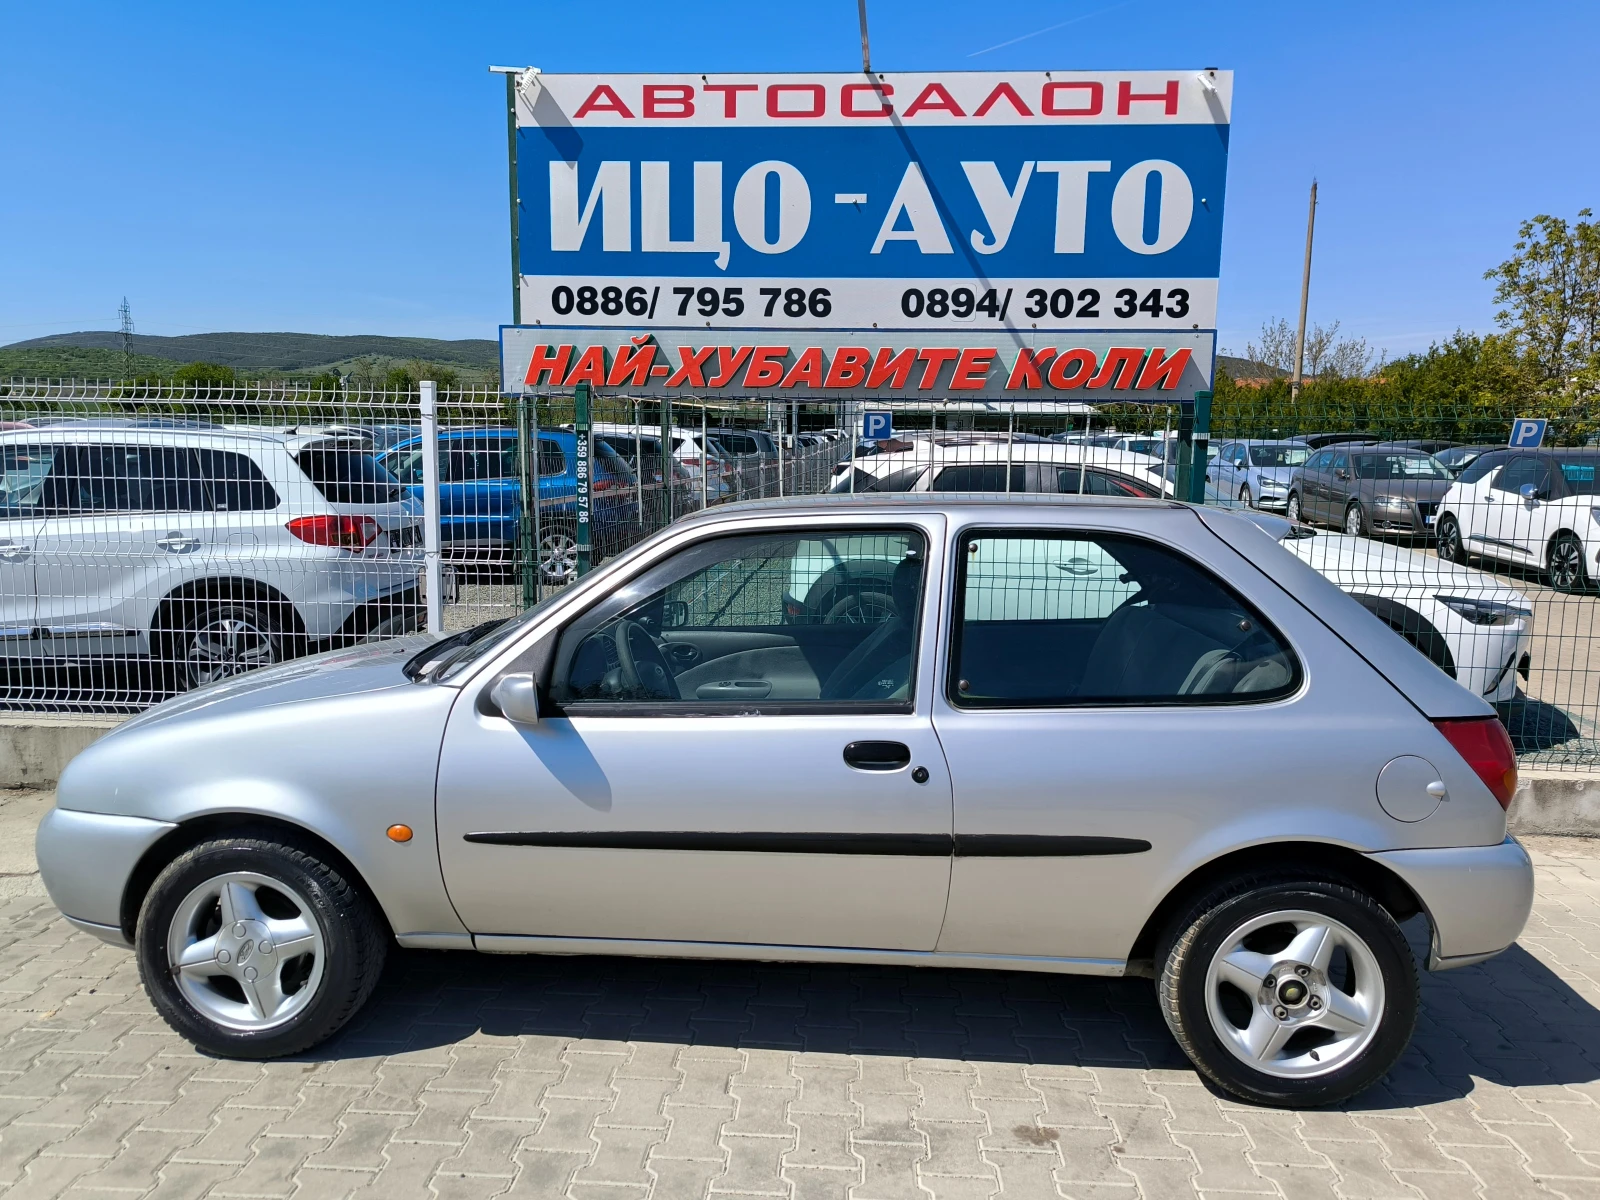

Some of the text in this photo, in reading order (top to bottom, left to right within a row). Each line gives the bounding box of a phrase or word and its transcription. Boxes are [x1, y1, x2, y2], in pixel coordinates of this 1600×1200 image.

[573, 81, 1179, 118] АВТОСАЛОН
[549, 159, 812, 270] ИЦО
[552, 286, 832, 319] 0886/ 795 786
[901, 287, 1190, 320] 0894/ 302 343
[524, 333, 1193, 390] НАЙ-ХУБАВИТЕ КОЛИ
[869, 415, 886, 436] P
[1516, 422, 1538, 445] P
[577, 433, 589, 523] +359 886 79 57 86
